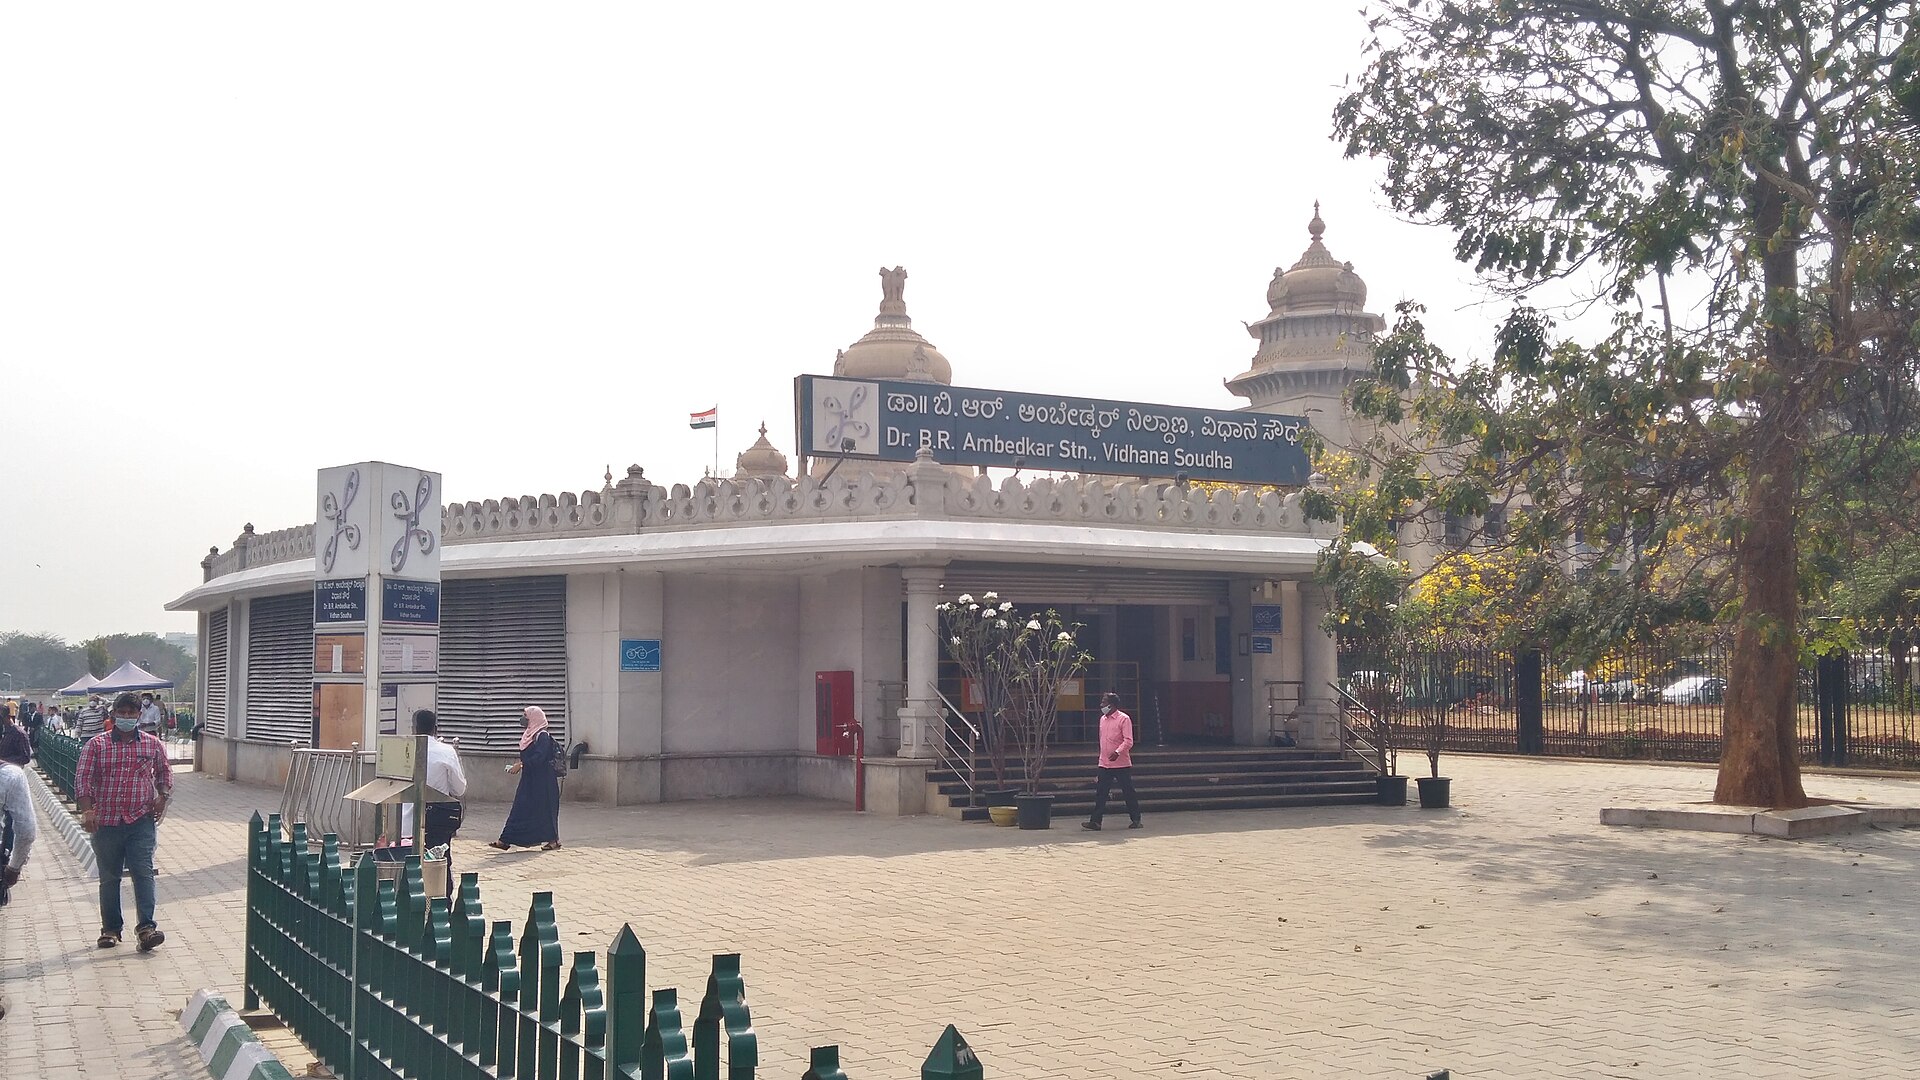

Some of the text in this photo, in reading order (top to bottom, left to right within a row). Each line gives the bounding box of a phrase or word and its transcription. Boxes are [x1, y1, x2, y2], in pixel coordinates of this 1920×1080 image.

[1018, 401, 1120, 439] ಅಂಬೇಡ್ಕರ್
[1126, 408, 1194, 445] ನಿಲ್ದಾಣ,
[1201, 415, 1257, 442] ವಿಧಾನ
[1262, 418, 1300, 446] ಸೌಧ
[887, 426, 1233, 470] Dr. B.R. Ambedkar Stn., Vidhana Soudha
